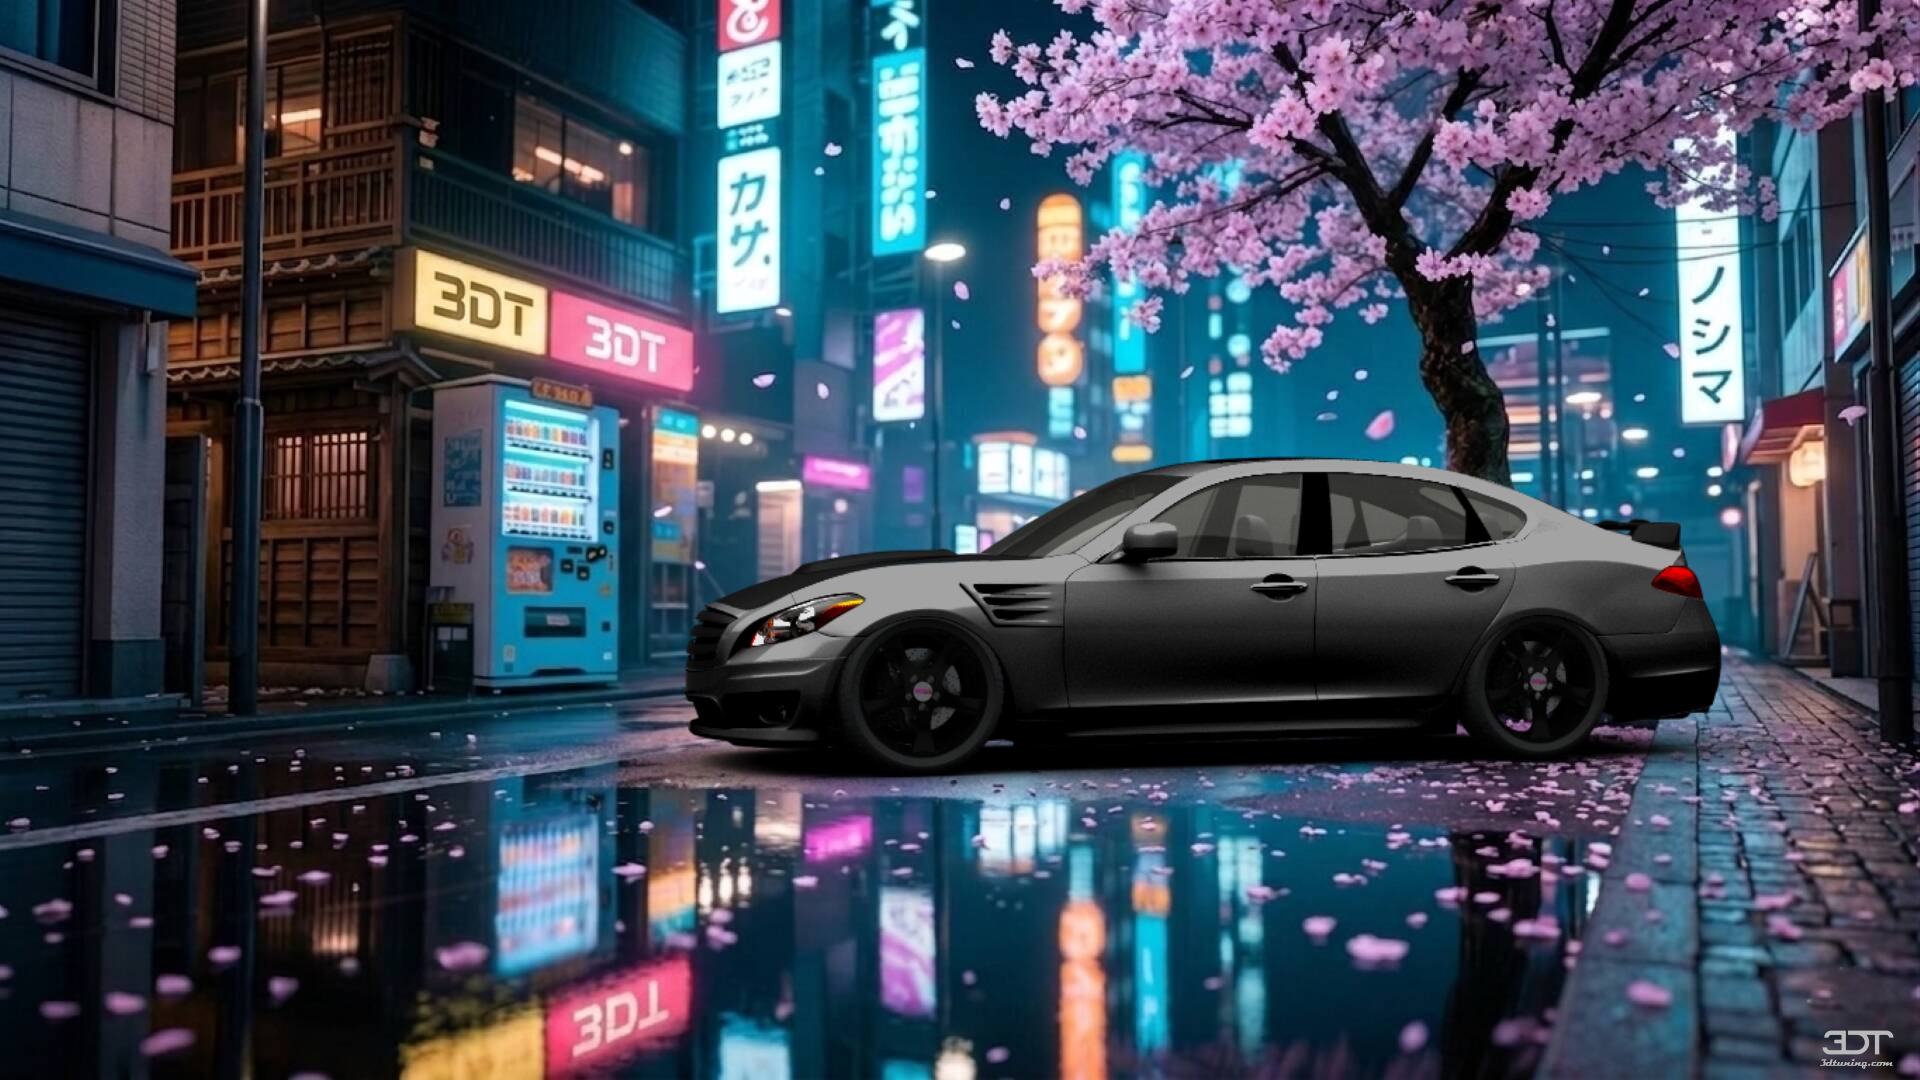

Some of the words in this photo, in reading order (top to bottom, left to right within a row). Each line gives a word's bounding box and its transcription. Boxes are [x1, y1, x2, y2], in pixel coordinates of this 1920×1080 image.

[433, 270, 534, 336] 3DT
[1691, 266, 1733, 404] ノシマ
[585, 315, 666, 373] 3DT
